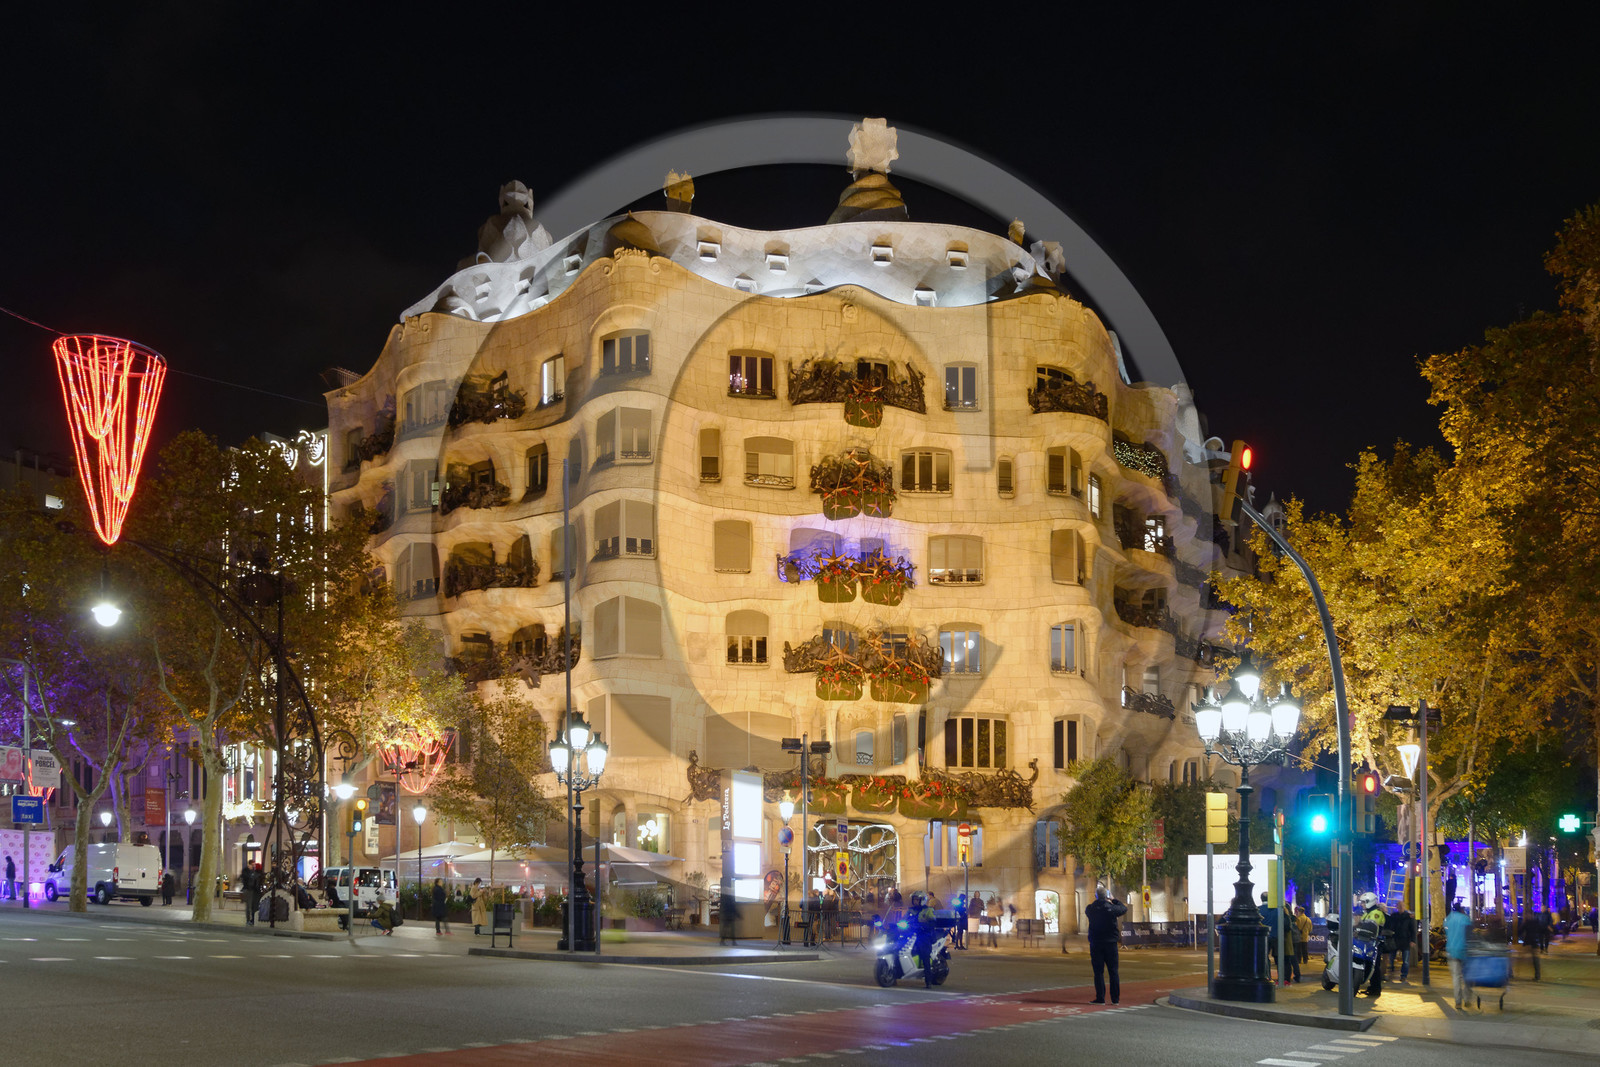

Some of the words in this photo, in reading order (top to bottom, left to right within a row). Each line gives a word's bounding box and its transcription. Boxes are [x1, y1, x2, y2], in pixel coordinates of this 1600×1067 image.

[35, 760, 55, 768] PORCEL
[722, 788, 730, 821] Pedrera
[722, 821, 731, 830] La
